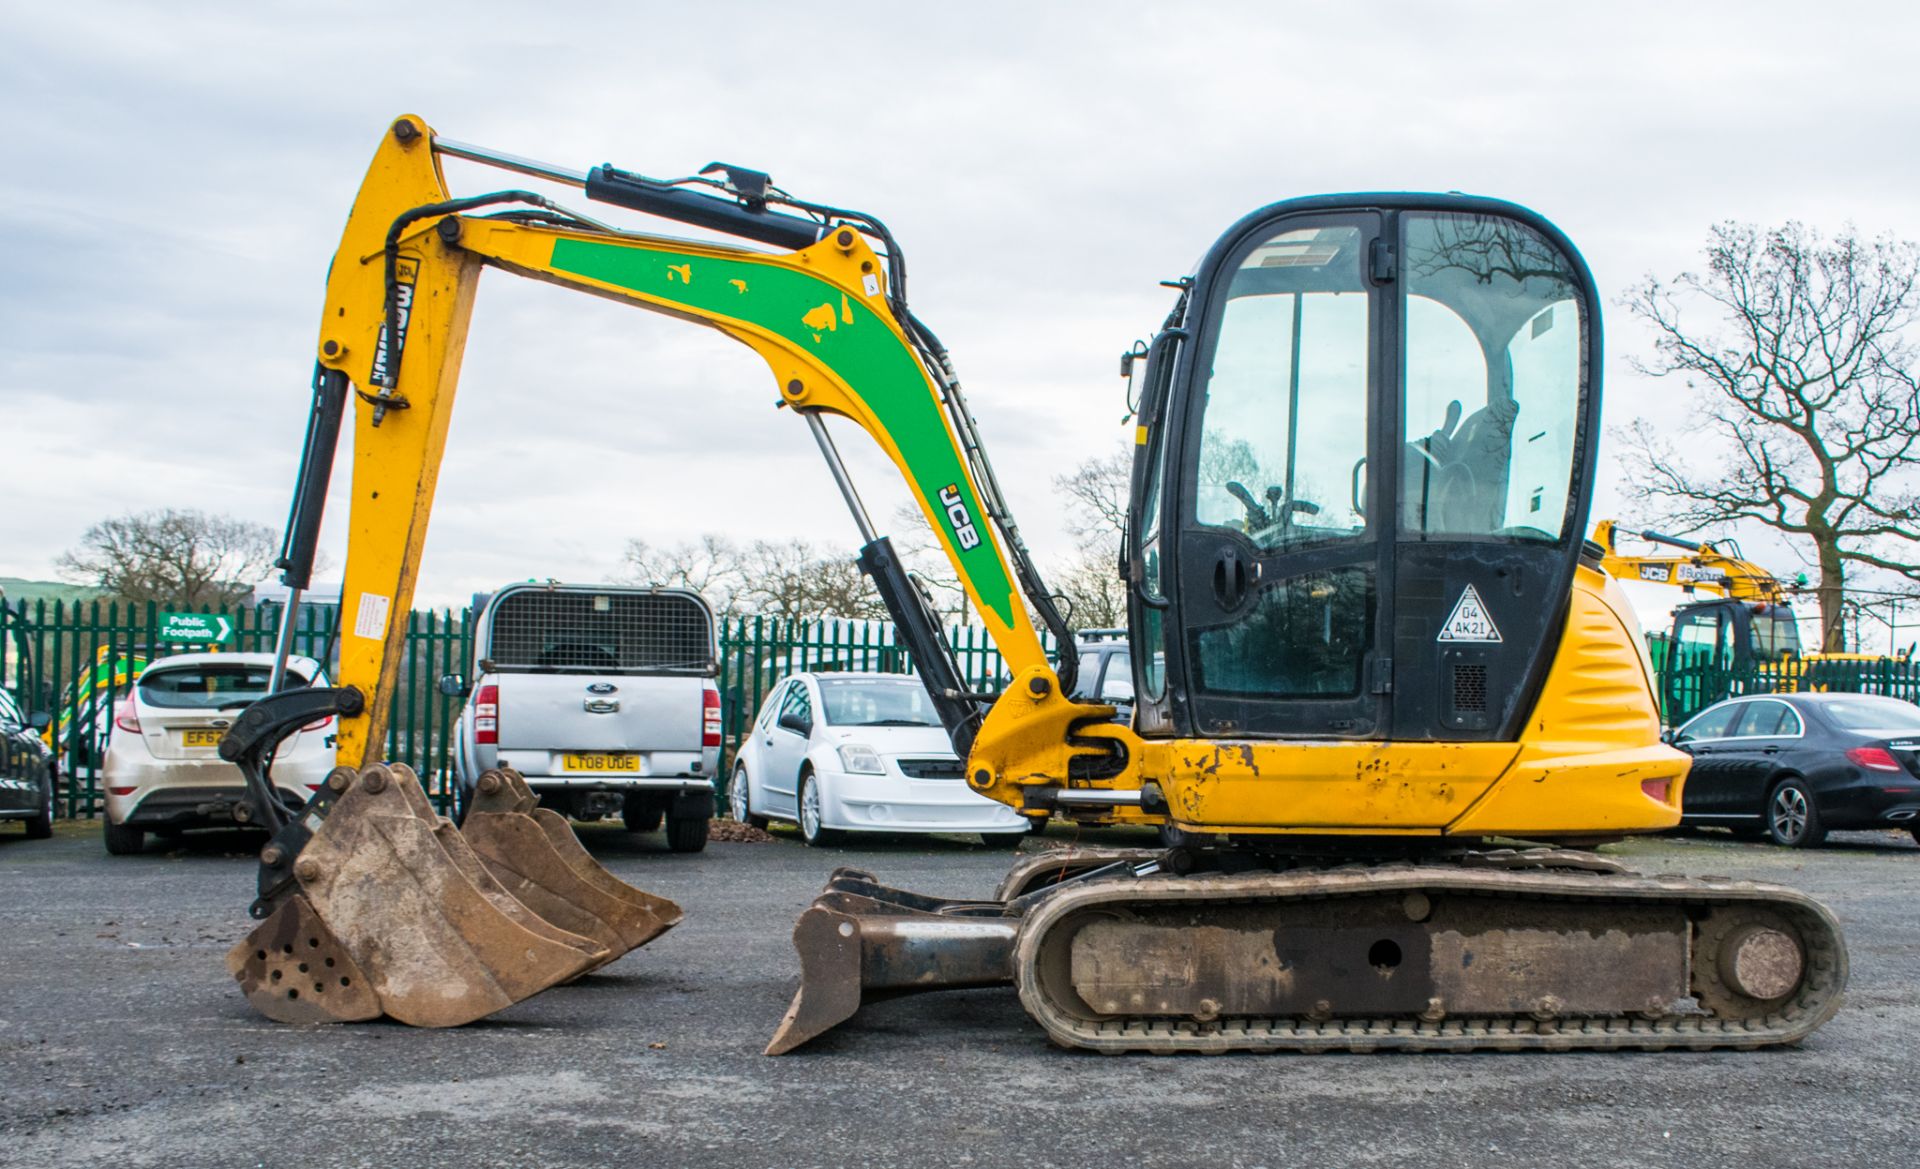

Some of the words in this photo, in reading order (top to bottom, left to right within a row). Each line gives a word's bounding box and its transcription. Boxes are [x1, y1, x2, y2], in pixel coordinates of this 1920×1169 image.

[939, 484, 980, 550] JCB
[1640, 567, 1669, 582] JCB
[169, 616, 206, 627] Public
[162, 626, 213, 639] Footpath
